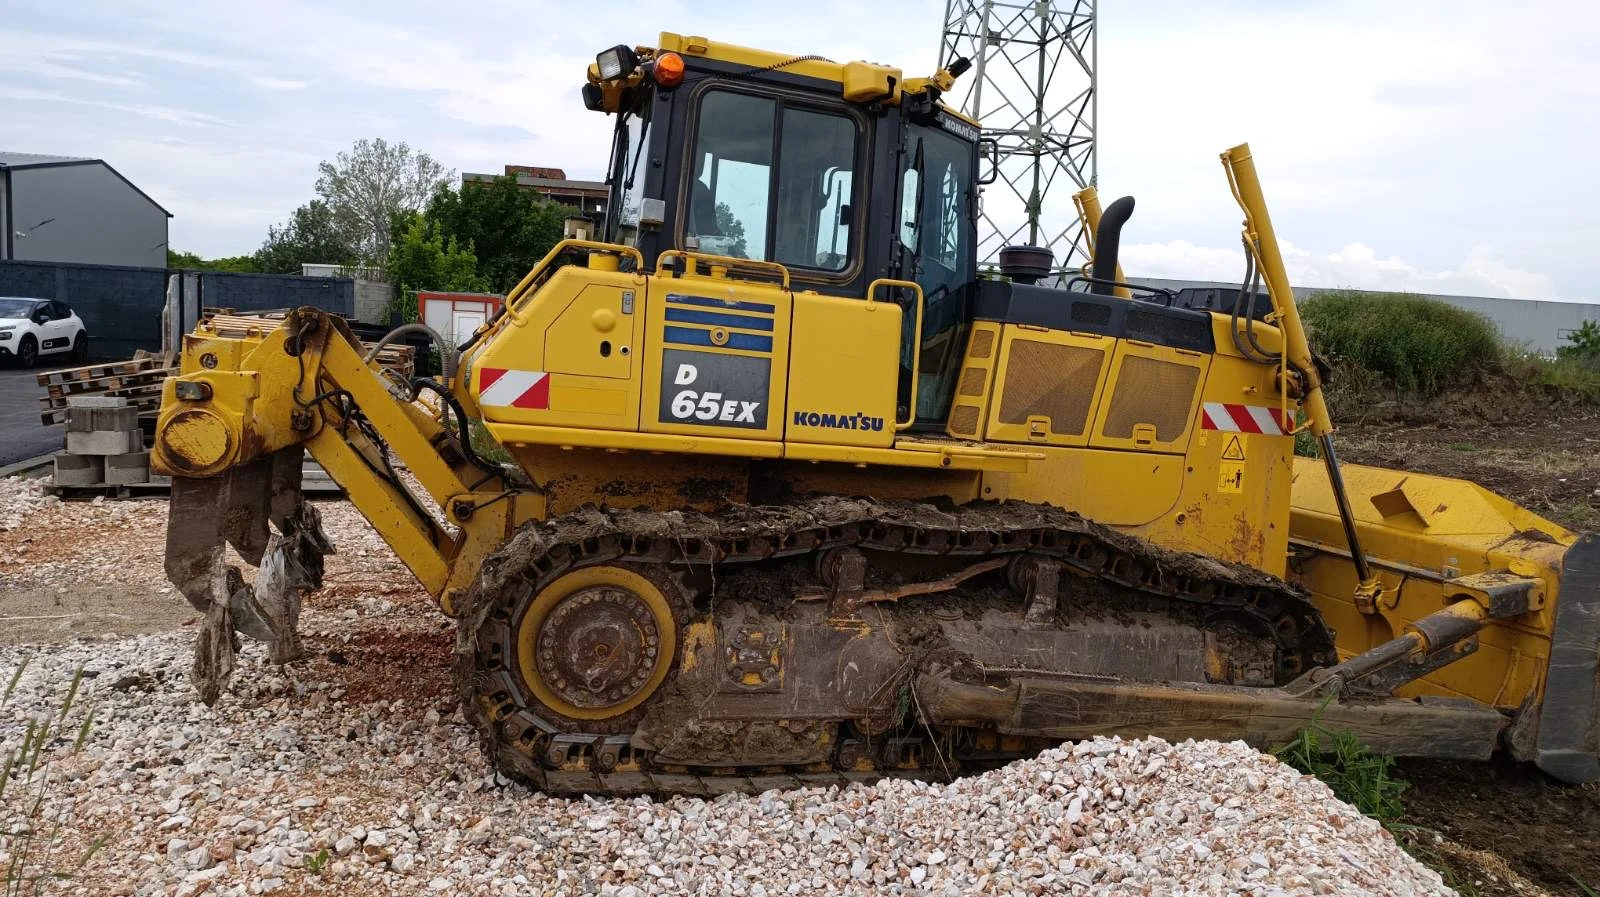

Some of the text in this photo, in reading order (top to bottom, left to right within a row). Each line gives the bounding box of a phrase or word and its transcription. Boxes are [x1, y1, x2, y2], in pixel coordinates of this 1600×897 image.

[945, 118, 978, 141] KOMATSU
[674, 364, 698, 385] D
[794, 411, 884, 432] KOMATSU
